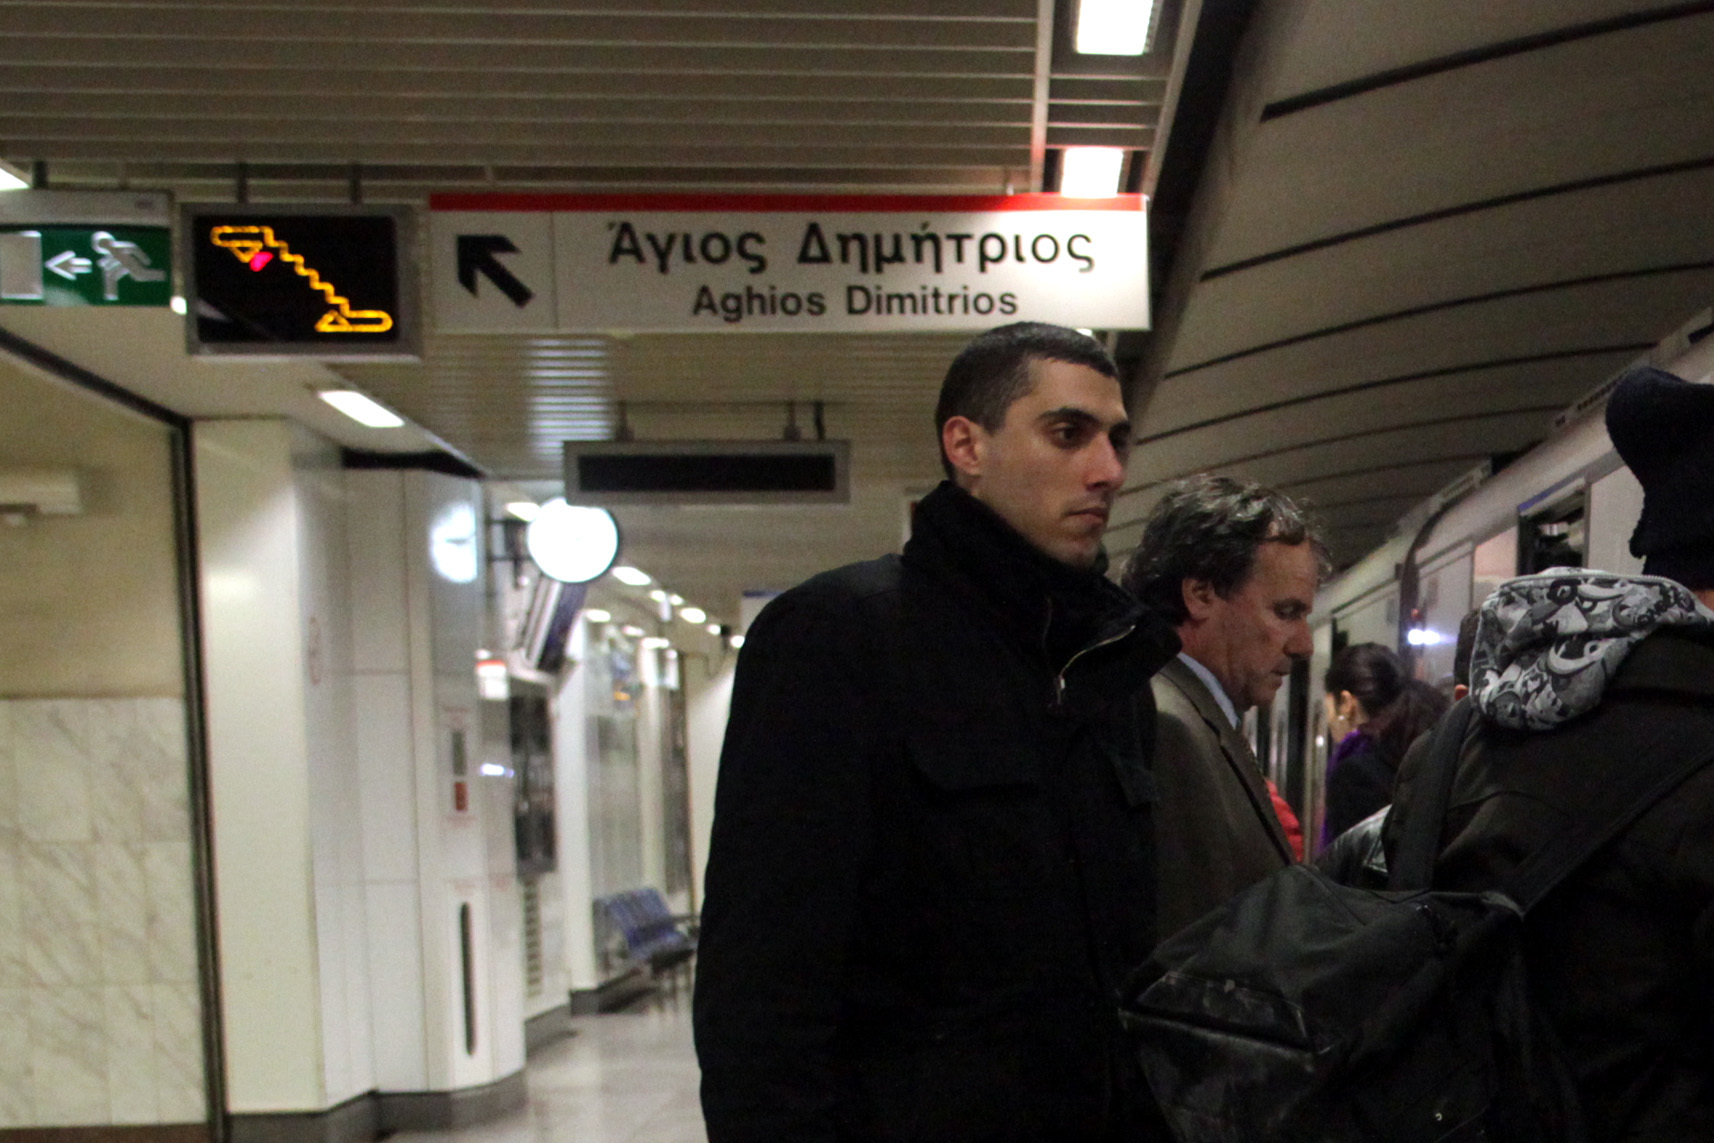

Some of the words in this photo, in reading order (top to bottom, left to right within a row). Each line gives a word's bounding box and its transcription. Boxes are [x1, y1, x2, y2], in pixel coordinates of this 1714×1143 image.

[607, 220, 768, 274] Άγιος
[797, 221, 1095, 273] Δημήτριος
[692, 284, 827, 323] Aghios
[845, 285, 1018, 317] Dimitrios
